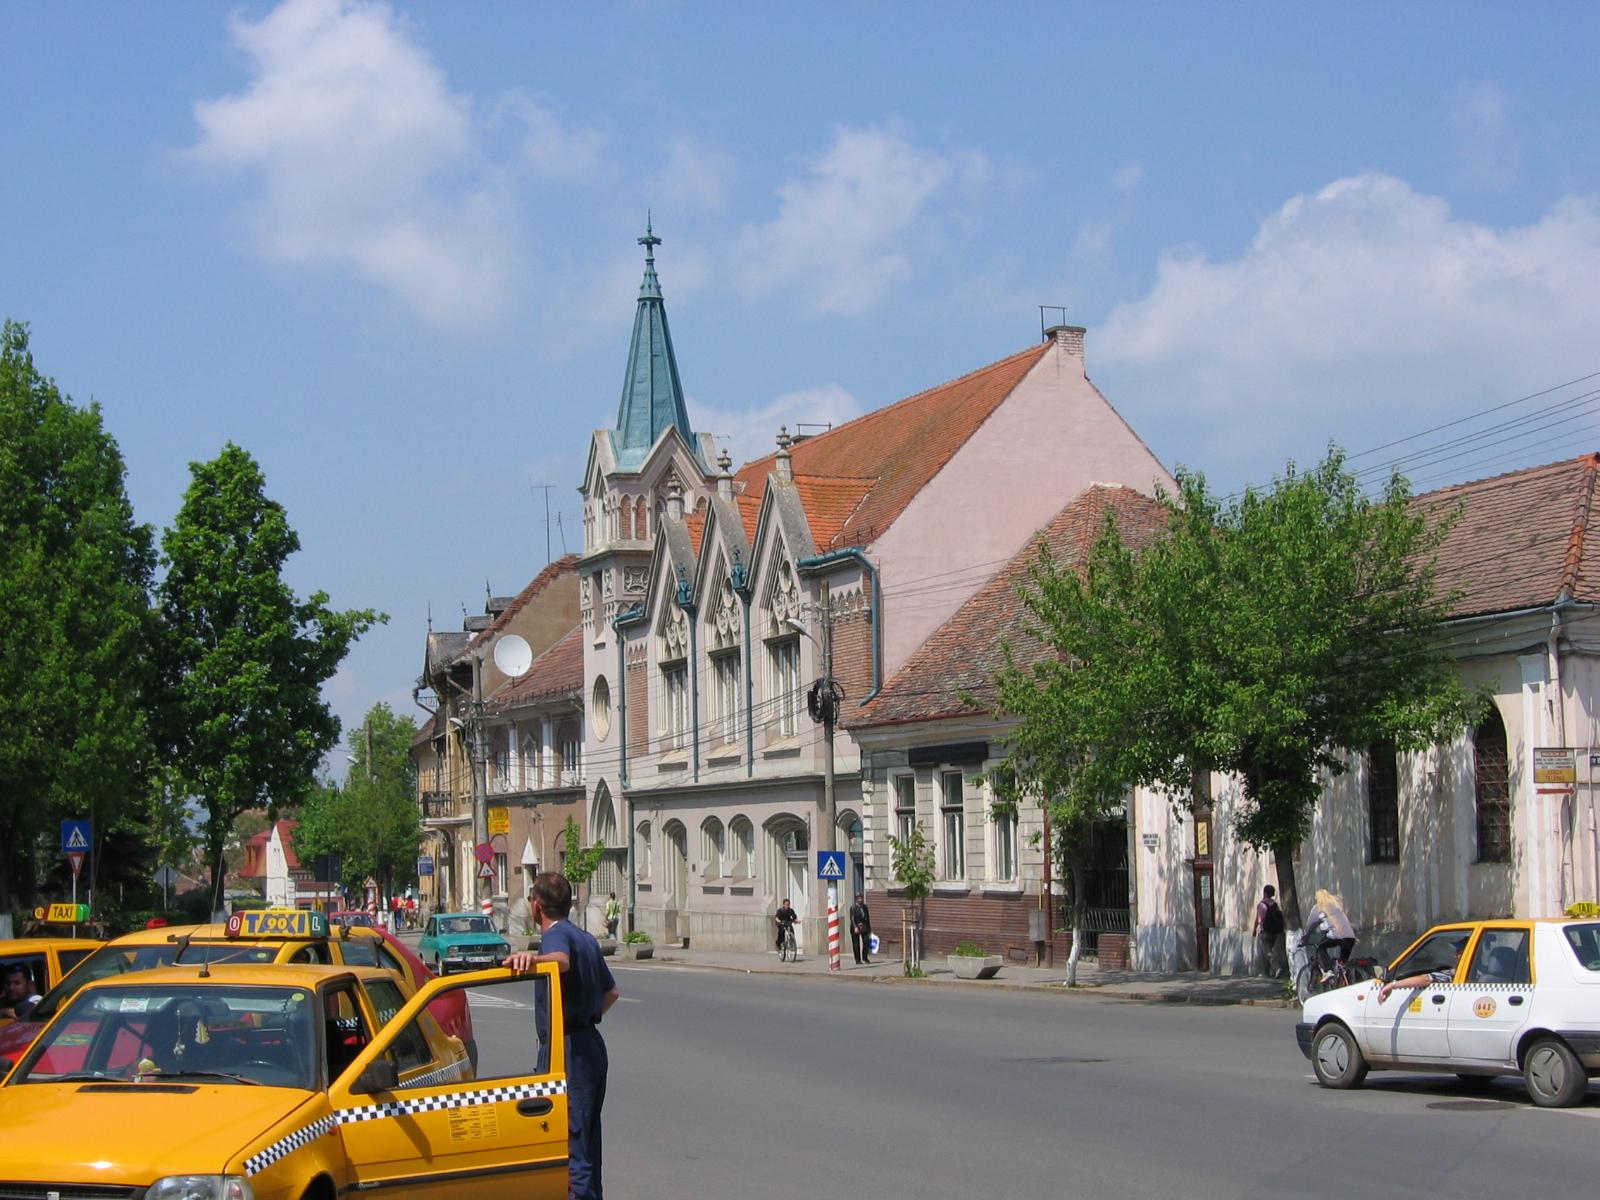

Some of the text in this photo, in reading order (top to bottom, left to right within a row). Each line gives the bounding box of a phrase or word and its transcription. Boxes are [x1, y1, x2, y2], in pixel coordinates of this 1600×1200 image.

[52, 905, 74, 918] TAXI
[1577, 902, 1593, 914] TAXI
[267, 917, 288, 931] 90
[312, 916, 321, 931] L
